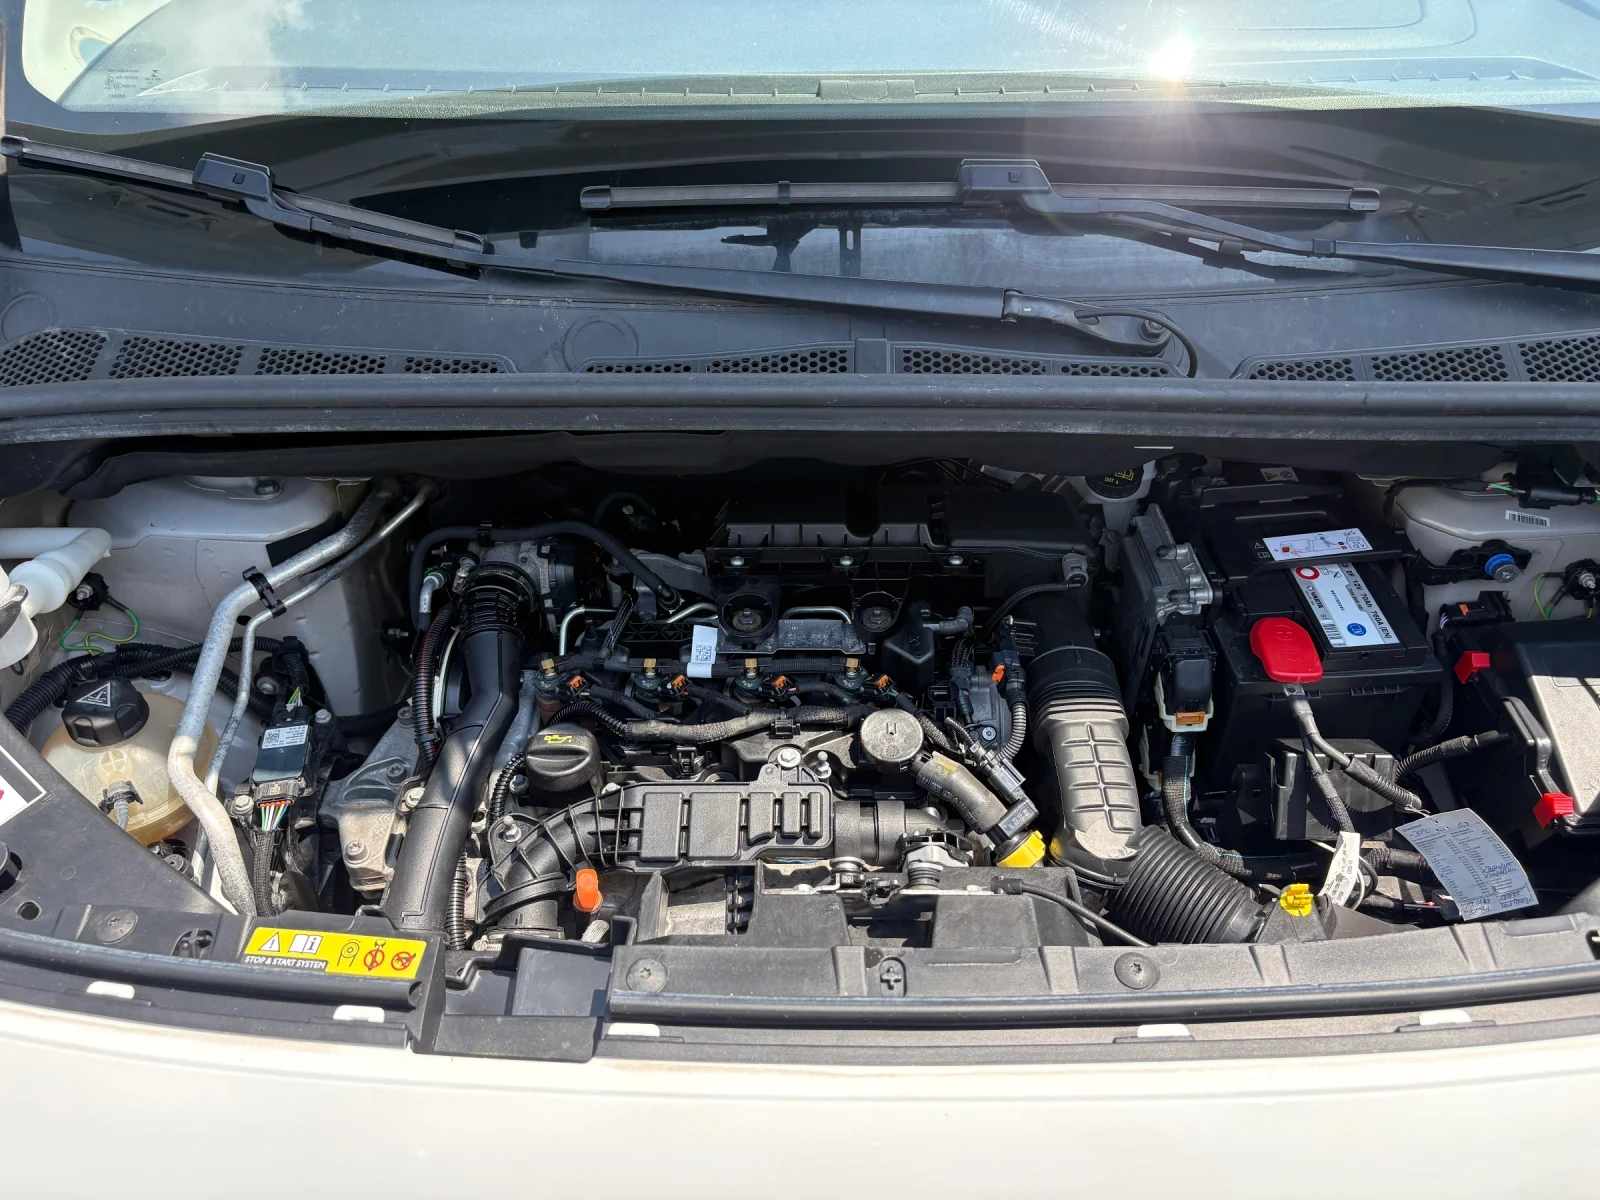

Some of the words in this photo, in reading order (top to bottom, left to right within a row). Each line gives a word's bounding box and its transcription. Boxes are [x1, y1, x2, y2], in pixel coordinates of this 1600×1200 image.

[1311, 588, 1323, 609] VARTA
[1353, 580, 1363, 591] 12V
[1360, 593, 1372, 608] 70Ah
[1371, 610, 1384, 626] 760A
[1380, 626, 1392, 639] (EN)
[244, 956, 266, 964] STOP
[272, 958, 296, 967] START
[296, 960, 326, 969] SYSTEM
